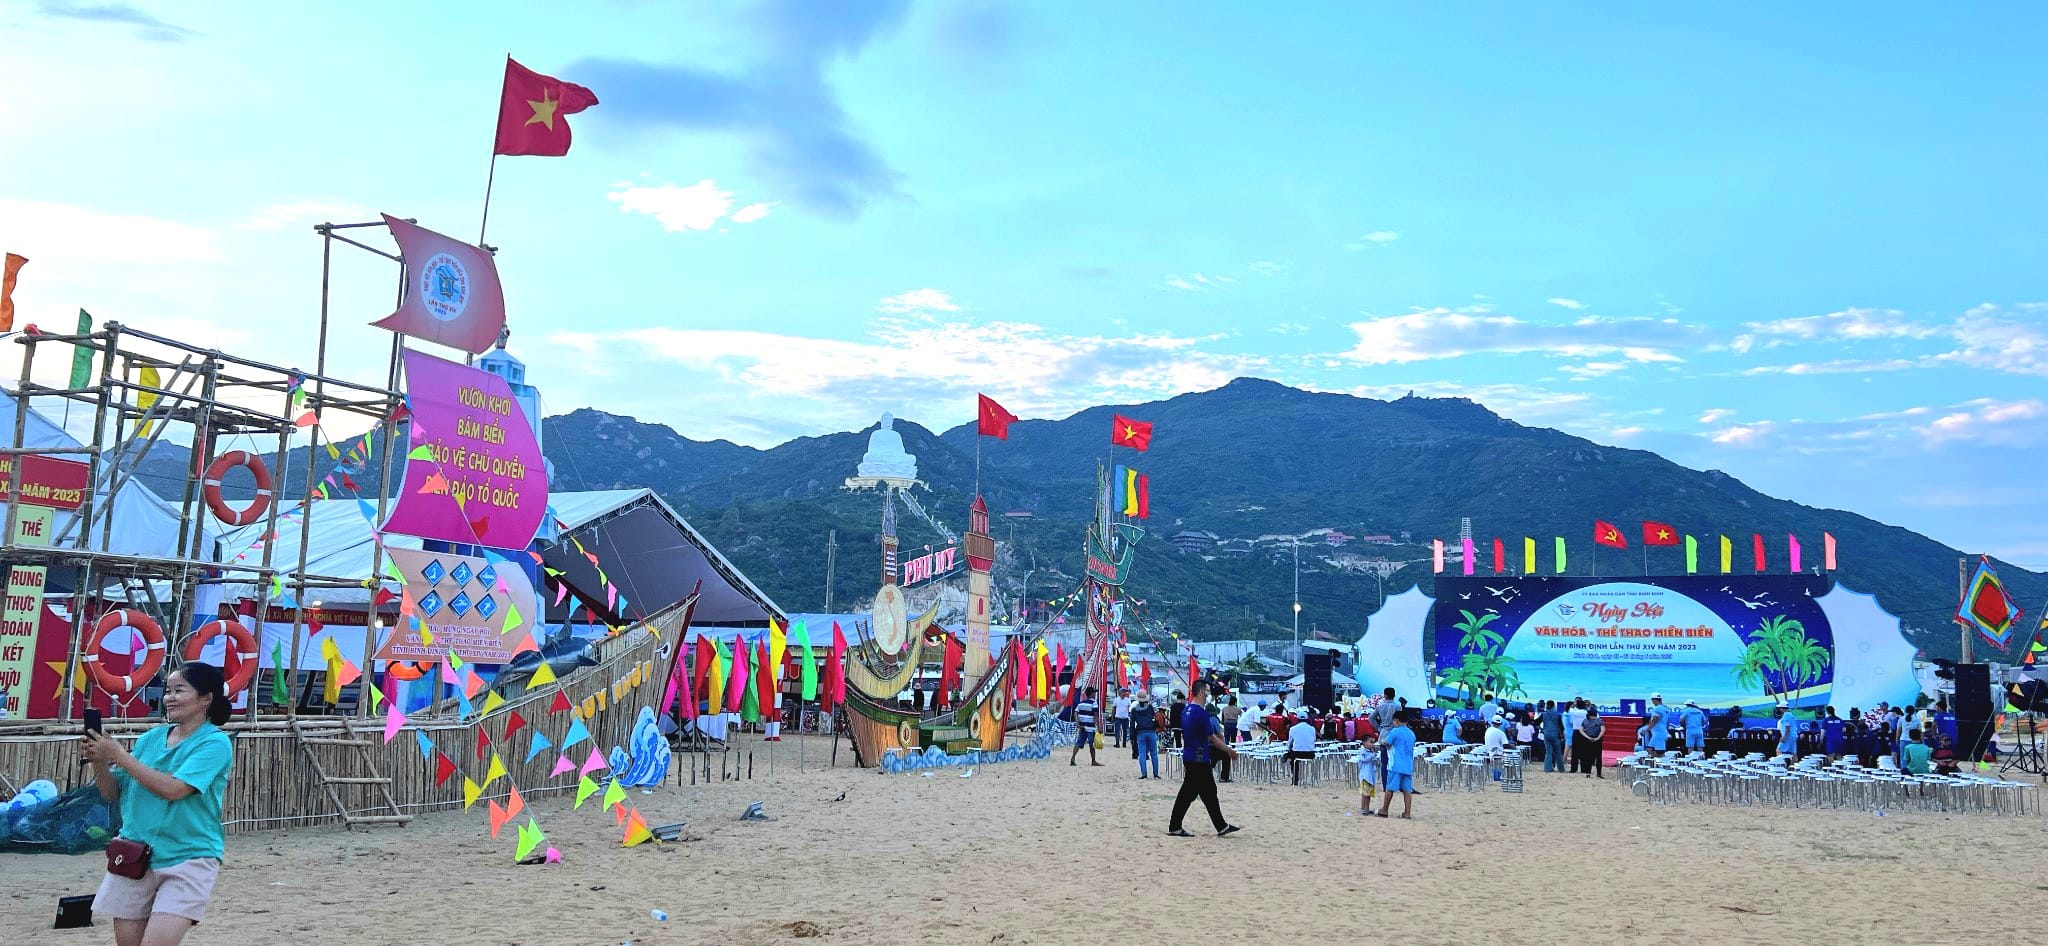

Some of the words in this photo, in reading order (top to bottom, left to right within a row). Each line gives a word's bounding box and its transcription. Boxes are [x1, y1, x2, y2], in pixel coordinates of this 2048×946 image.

[458, 386, 486, 411] VƯƠN
[457, 415, 481, 440] BÁM
[483, 418, 506, 446] BIỂN
[428, 437, 450, 464] BẢO
[453, 446, 466, 471] VỆ
[468, 448, 490, 473] CHỦ
[492, 454, 525, 481] QUYỀN
[22, 482, 50, 499] NĂM
[52, 488, 81, 503] 2023
[451, 474, 475, 501] ĐẢO
[477, 477, 491, 504] TỔ
[492, 482, 520, 509] QUỐC
[21, 516, 44, 537] THỂ
[11, 570, 43, 587] RUNG
[6, 594, 35, 614] THỰC
[1582, 602, 1628, 623] Ngày
[1631, 602, 1665, 619] Hội
[1534, 625, 1559, 637] VĂN
[1561, 625, 1588, 637] HÓA
[1596, 624, 1617, 638] THỂ
[1620, 627, 1652, 638] THAO
[1653, 625, 1683, 638] MIỀN
[1686, 624, 1713, 638] BIỂN
[3, 641, 25, 661] KẾT
[1588, 643, 1608, 651] ĐỊNH
[1628, 703, 1638, 715] 1
